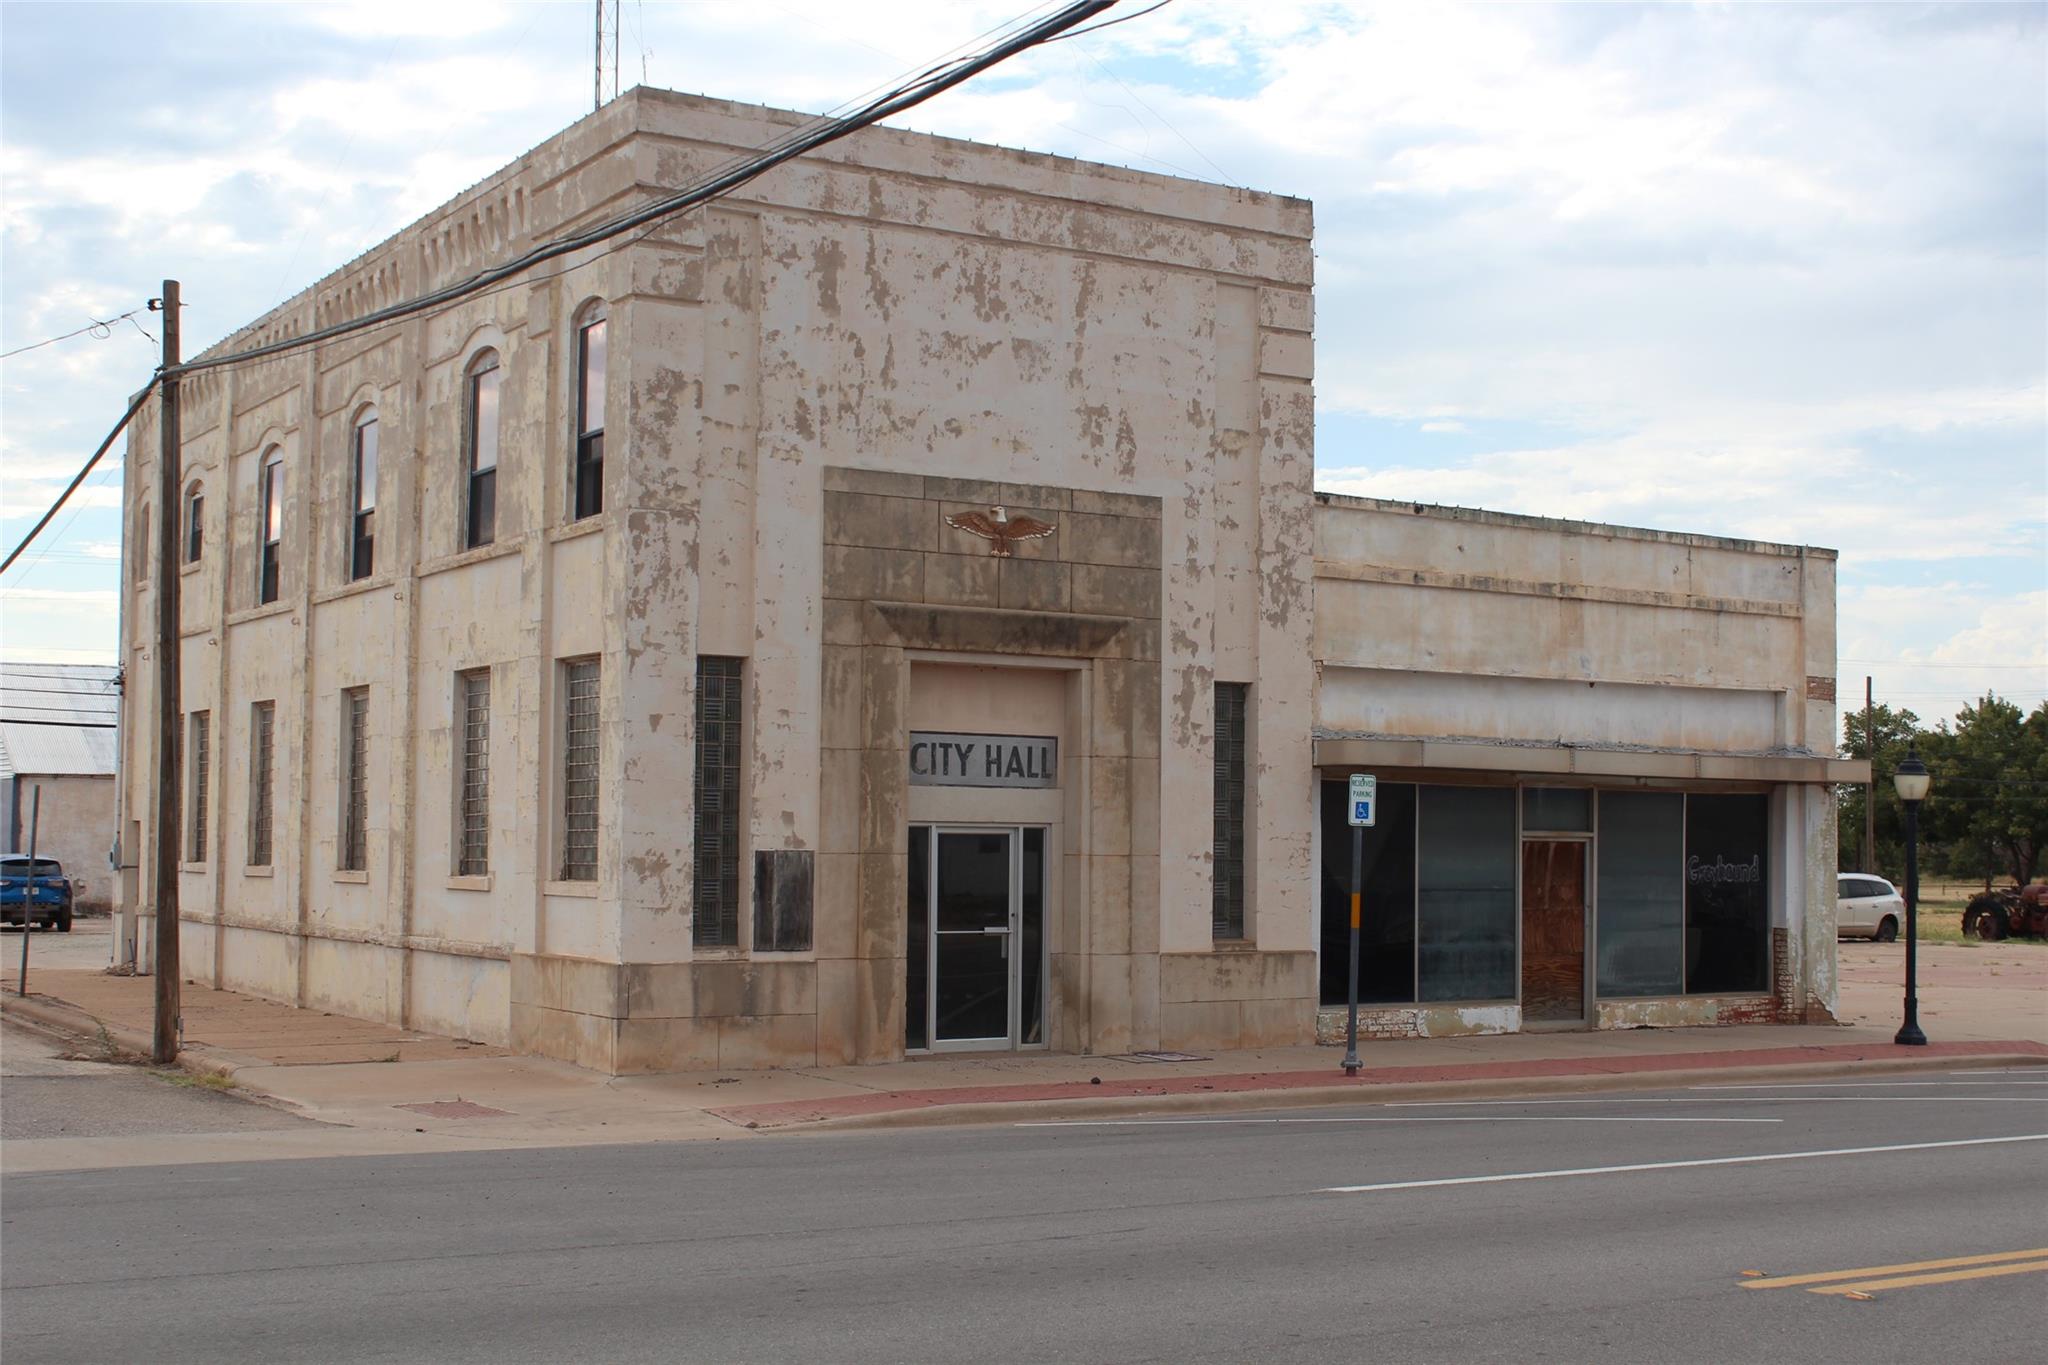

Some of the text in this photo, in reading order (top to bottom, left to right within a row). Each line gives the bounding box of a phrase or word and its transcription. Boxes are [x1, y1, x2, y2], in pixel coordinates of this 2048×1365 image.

[910, 743, 1053, 779] CITY HALL
[1351, 779, 1374, 787] RESERVED
[1352, 790, 1373, 798] PARKING
[1687, 854, 1760, 888] Greyhound
